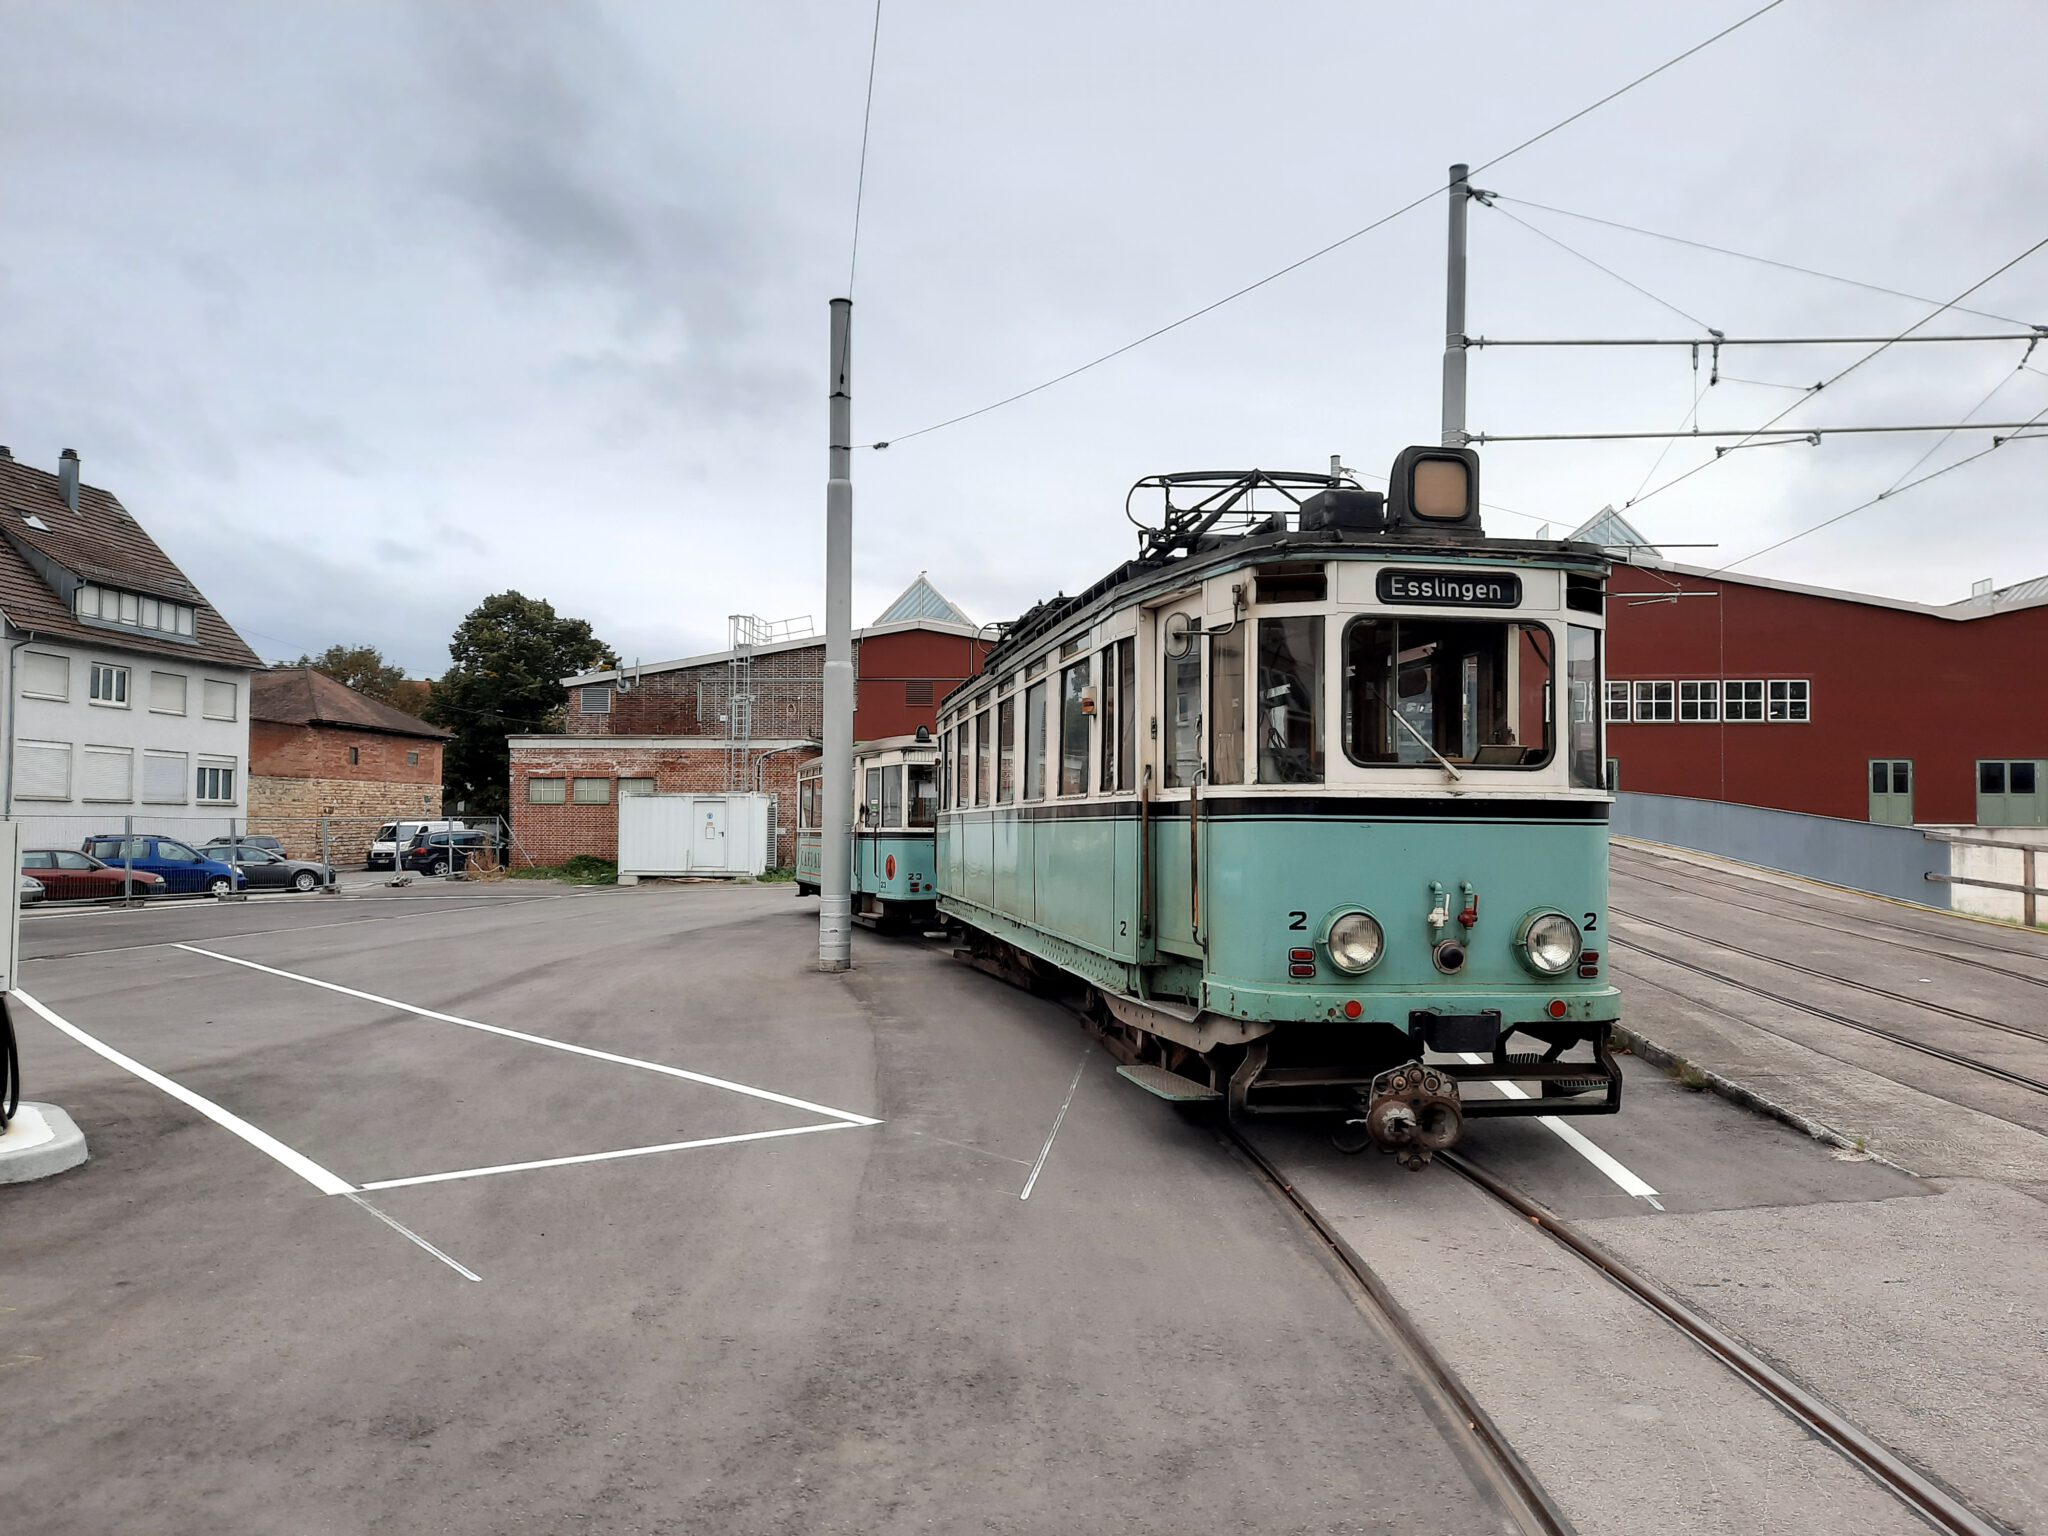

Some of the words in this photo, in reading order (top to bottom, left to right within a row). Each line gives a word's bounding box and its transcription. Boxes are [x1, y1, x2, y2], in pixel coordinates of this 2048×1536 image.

[1391, 576, 1501, 600] Esslingen
[1120, 920, 1127, 936] 2
[1288, 911, 1307, 930] 2
[1583, 912, 1597, 931] 2
